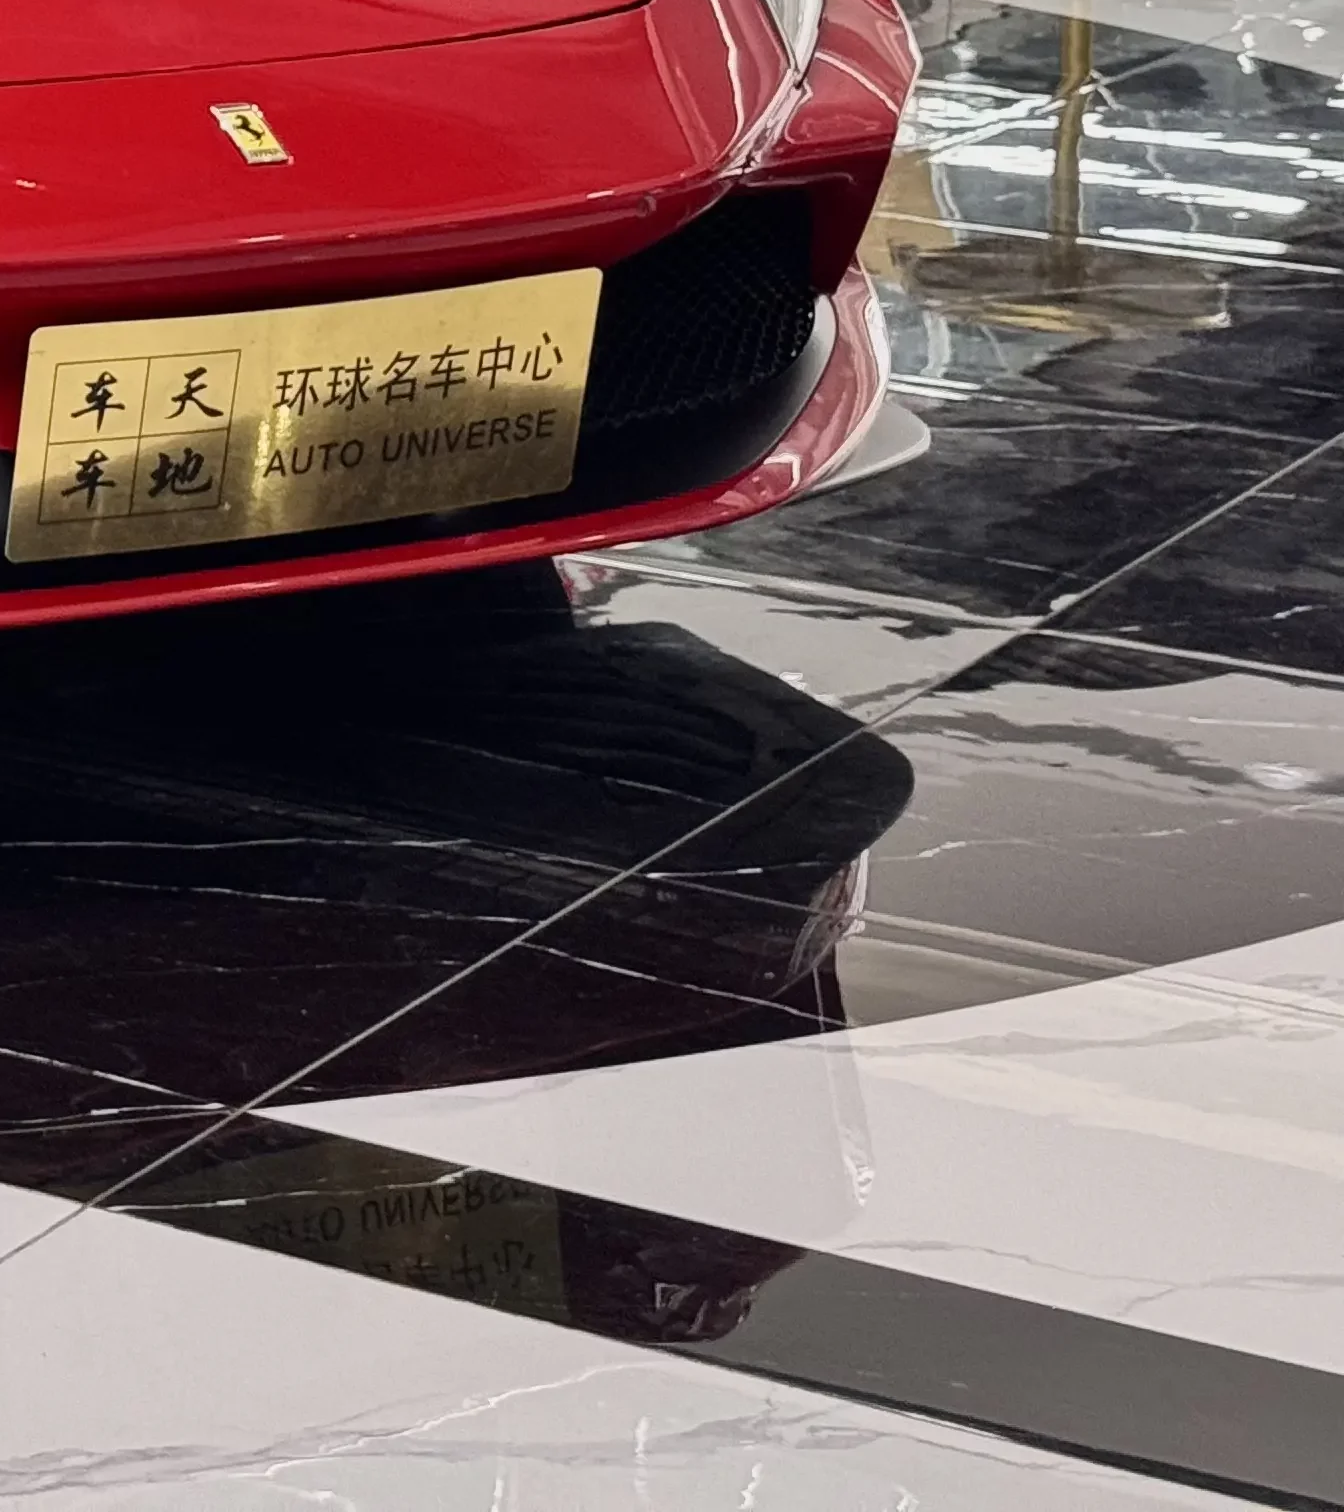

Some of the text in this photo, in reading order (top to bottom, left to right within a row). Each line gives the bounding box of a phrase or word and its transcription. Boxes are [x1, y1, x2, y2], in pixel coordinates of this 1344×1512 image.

[272, 331, 563, 417] 环球名车中心
[263, 407, 558, 478] AUTO UNIVERSE
